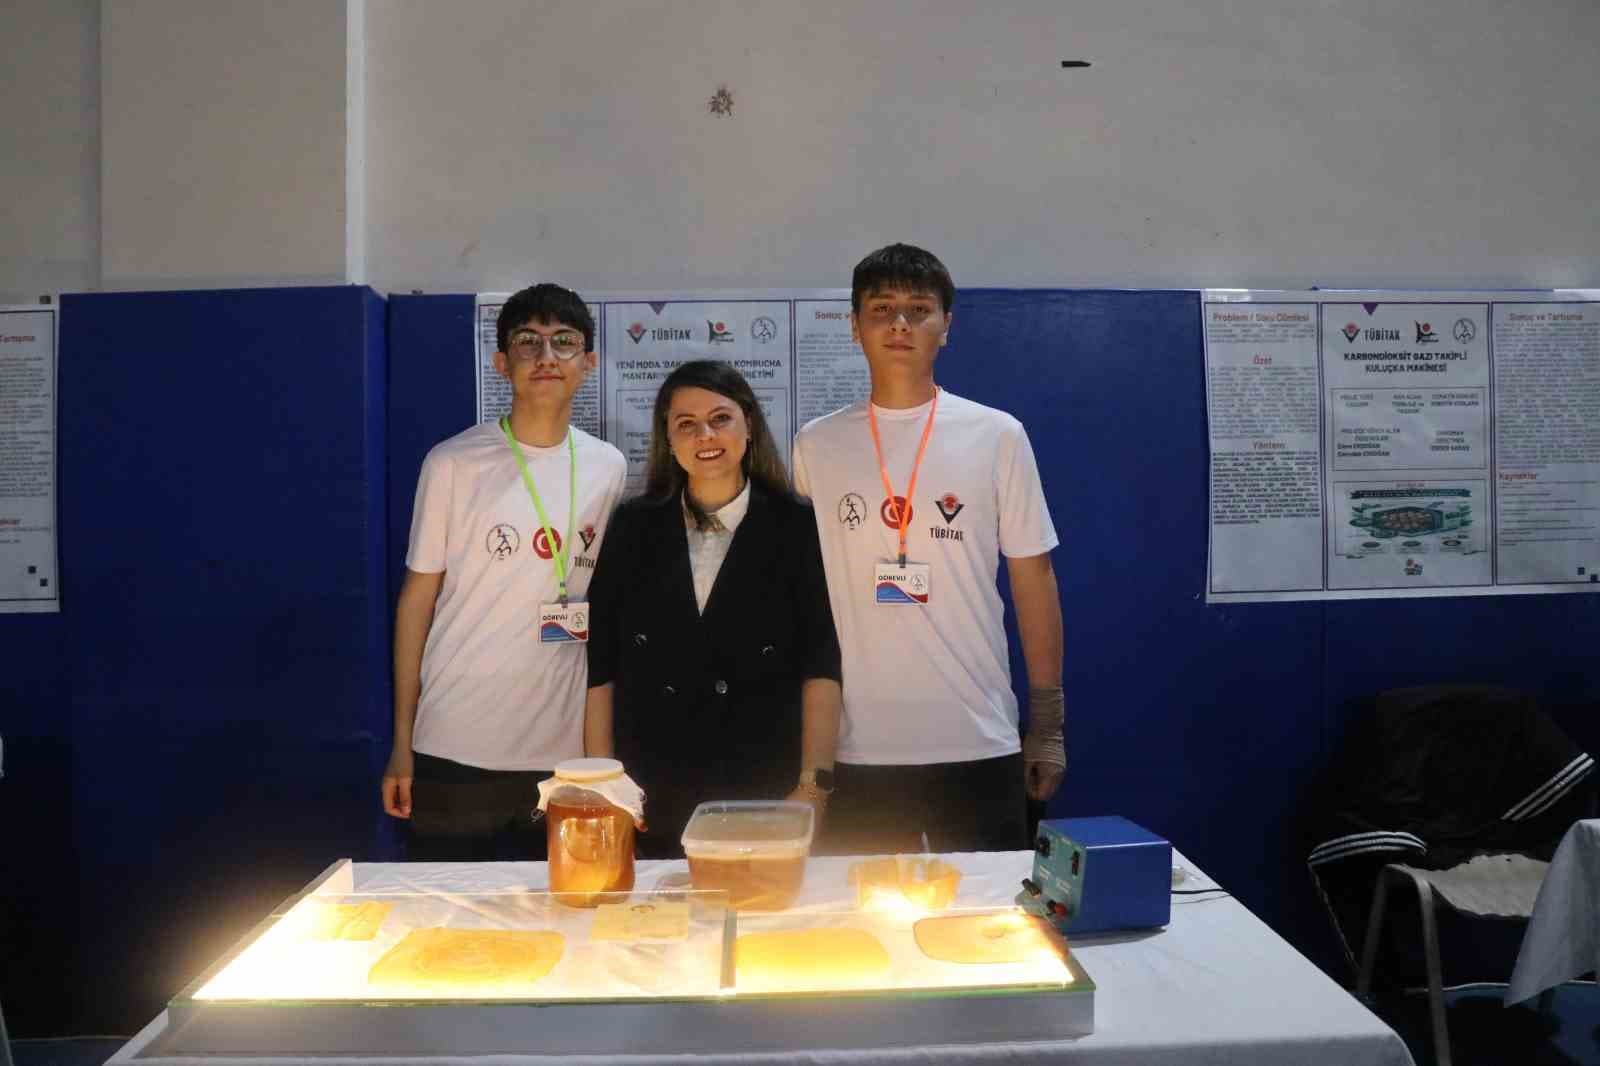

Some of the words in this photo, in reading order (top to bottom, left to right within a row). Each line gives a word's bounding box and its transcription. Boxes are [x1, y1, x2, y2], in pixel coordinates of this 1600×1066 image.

[652, 328, 692, 341] TÜBİTAK
[1364, 328, 1400, 341] TÜBİTAK
[1344, 350, 1411, 361] KARBONDİOKSİT
[734, 359, 782, 369] KOMBUCHA
[1365, 363, 1405, 374] KULUÇKA
[1406, 362, 1448, 372] MAKİNESİ
